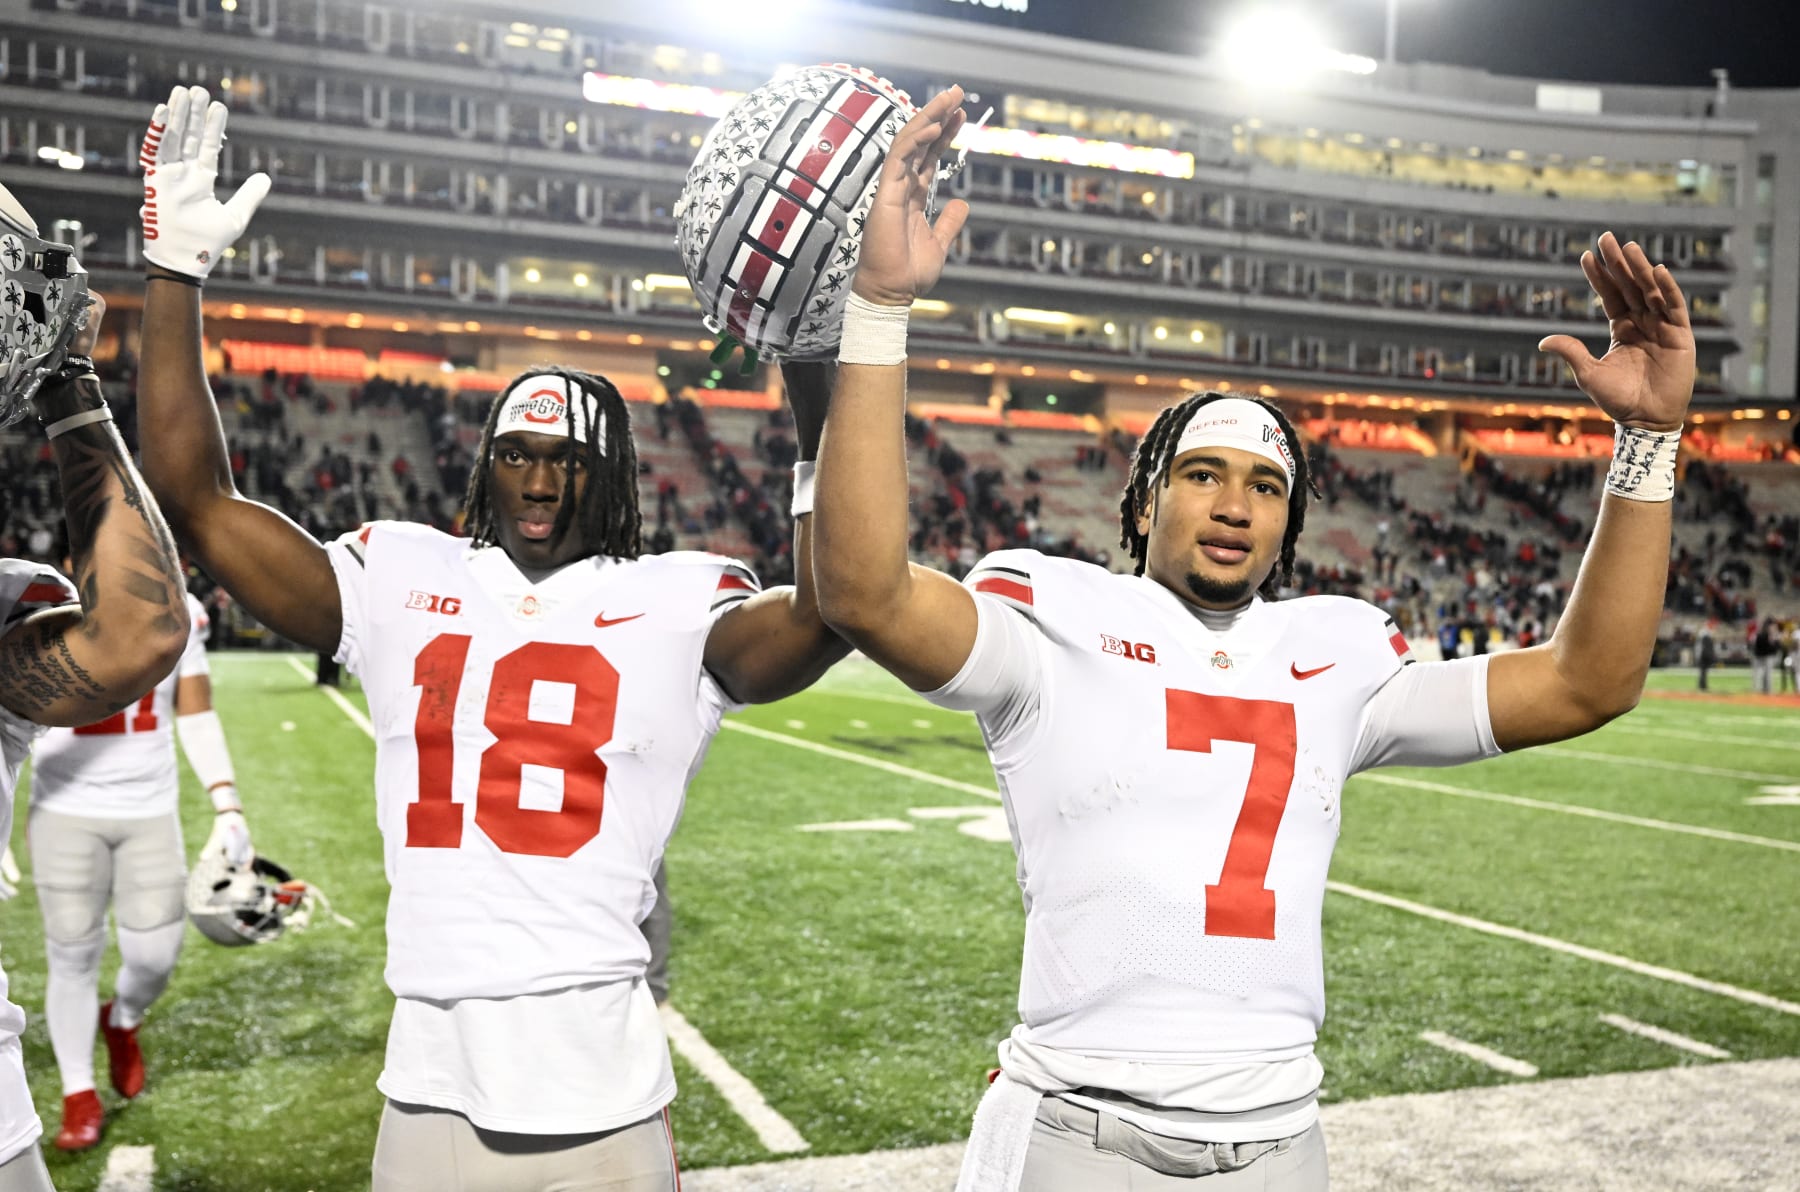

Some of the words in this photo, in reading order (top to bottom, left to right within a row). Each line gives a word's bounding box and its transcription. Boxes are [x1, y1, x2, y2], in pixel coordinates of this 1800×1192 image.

[1188, 418, 1238, 433] DEFEND
[405, 633, 620, 858] 18
[1165, 687, 1298, 940] 7
